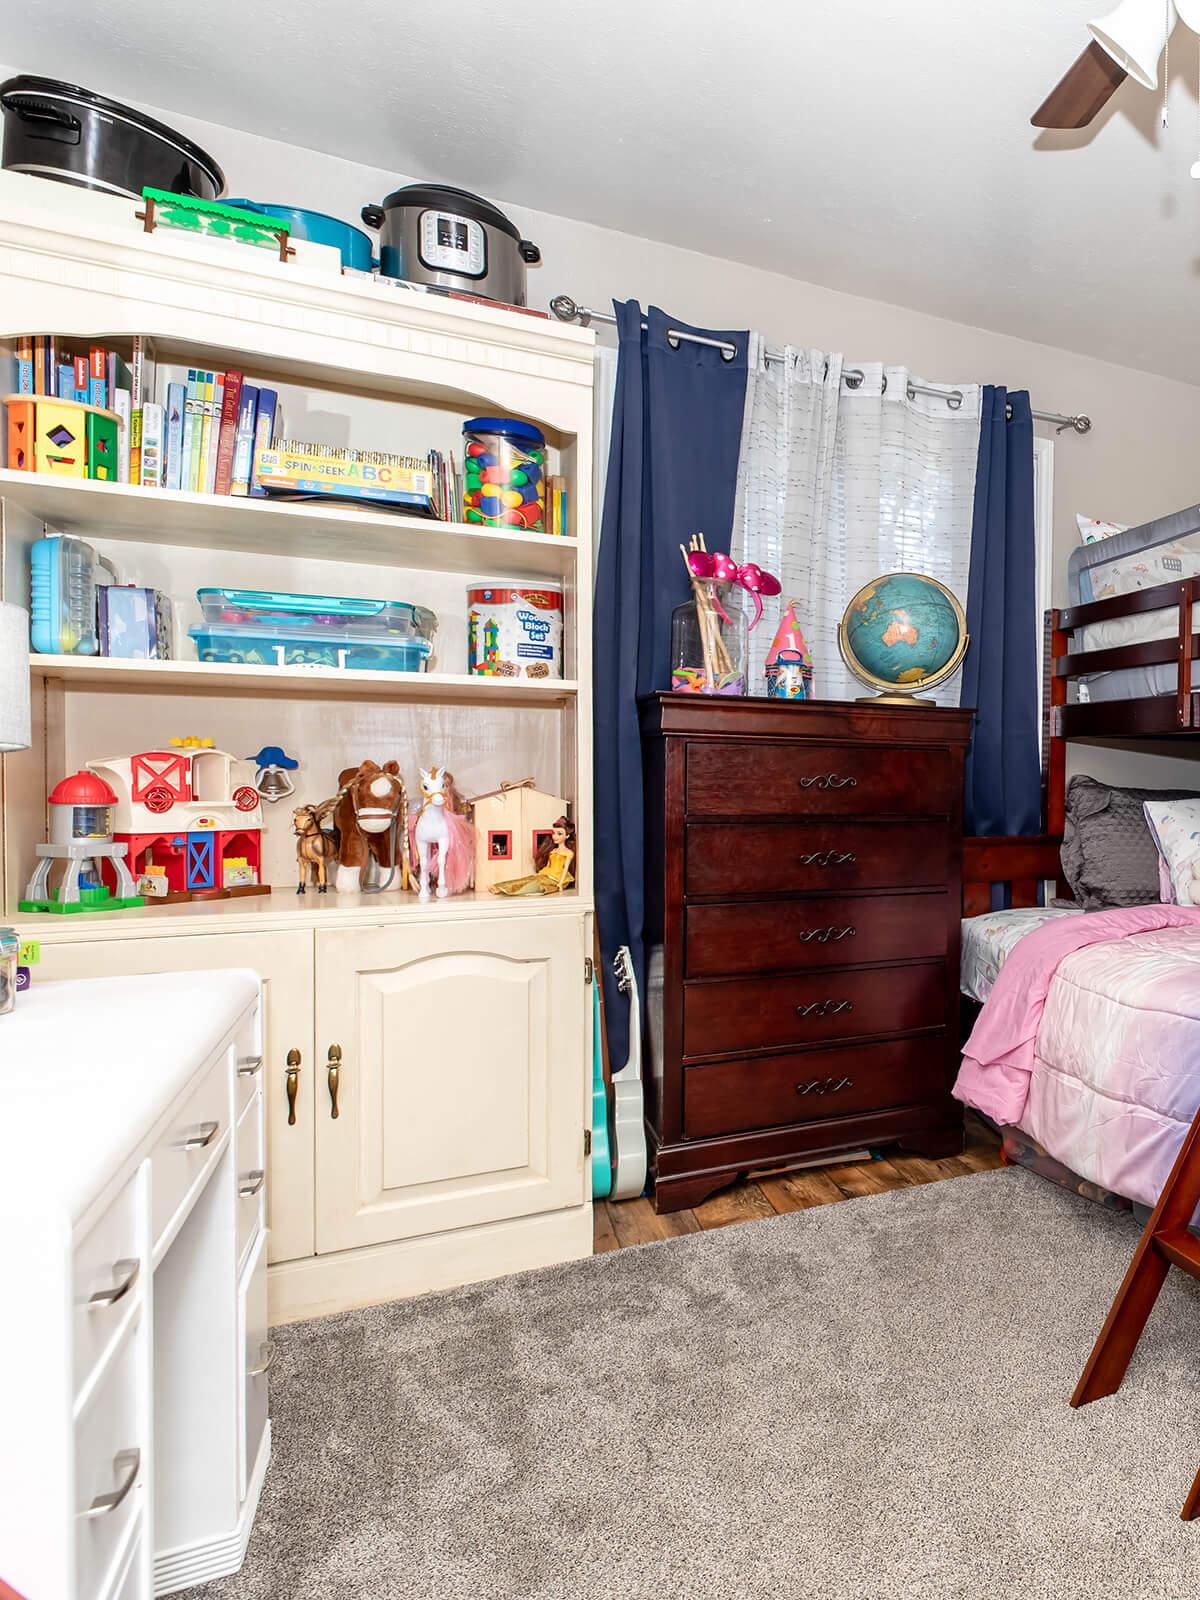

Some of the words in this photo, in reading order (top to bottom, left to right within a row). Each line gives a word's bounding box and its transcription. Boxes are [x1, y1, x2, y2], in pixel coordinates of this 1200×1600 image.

[285, 460, 312, 472] SPIN
[318, 465, 345, 476] SEEK
[347, 464, 392, 482] ABC
[525, 622, 549, 632] Block
[531, 631, 545, 640] Set
